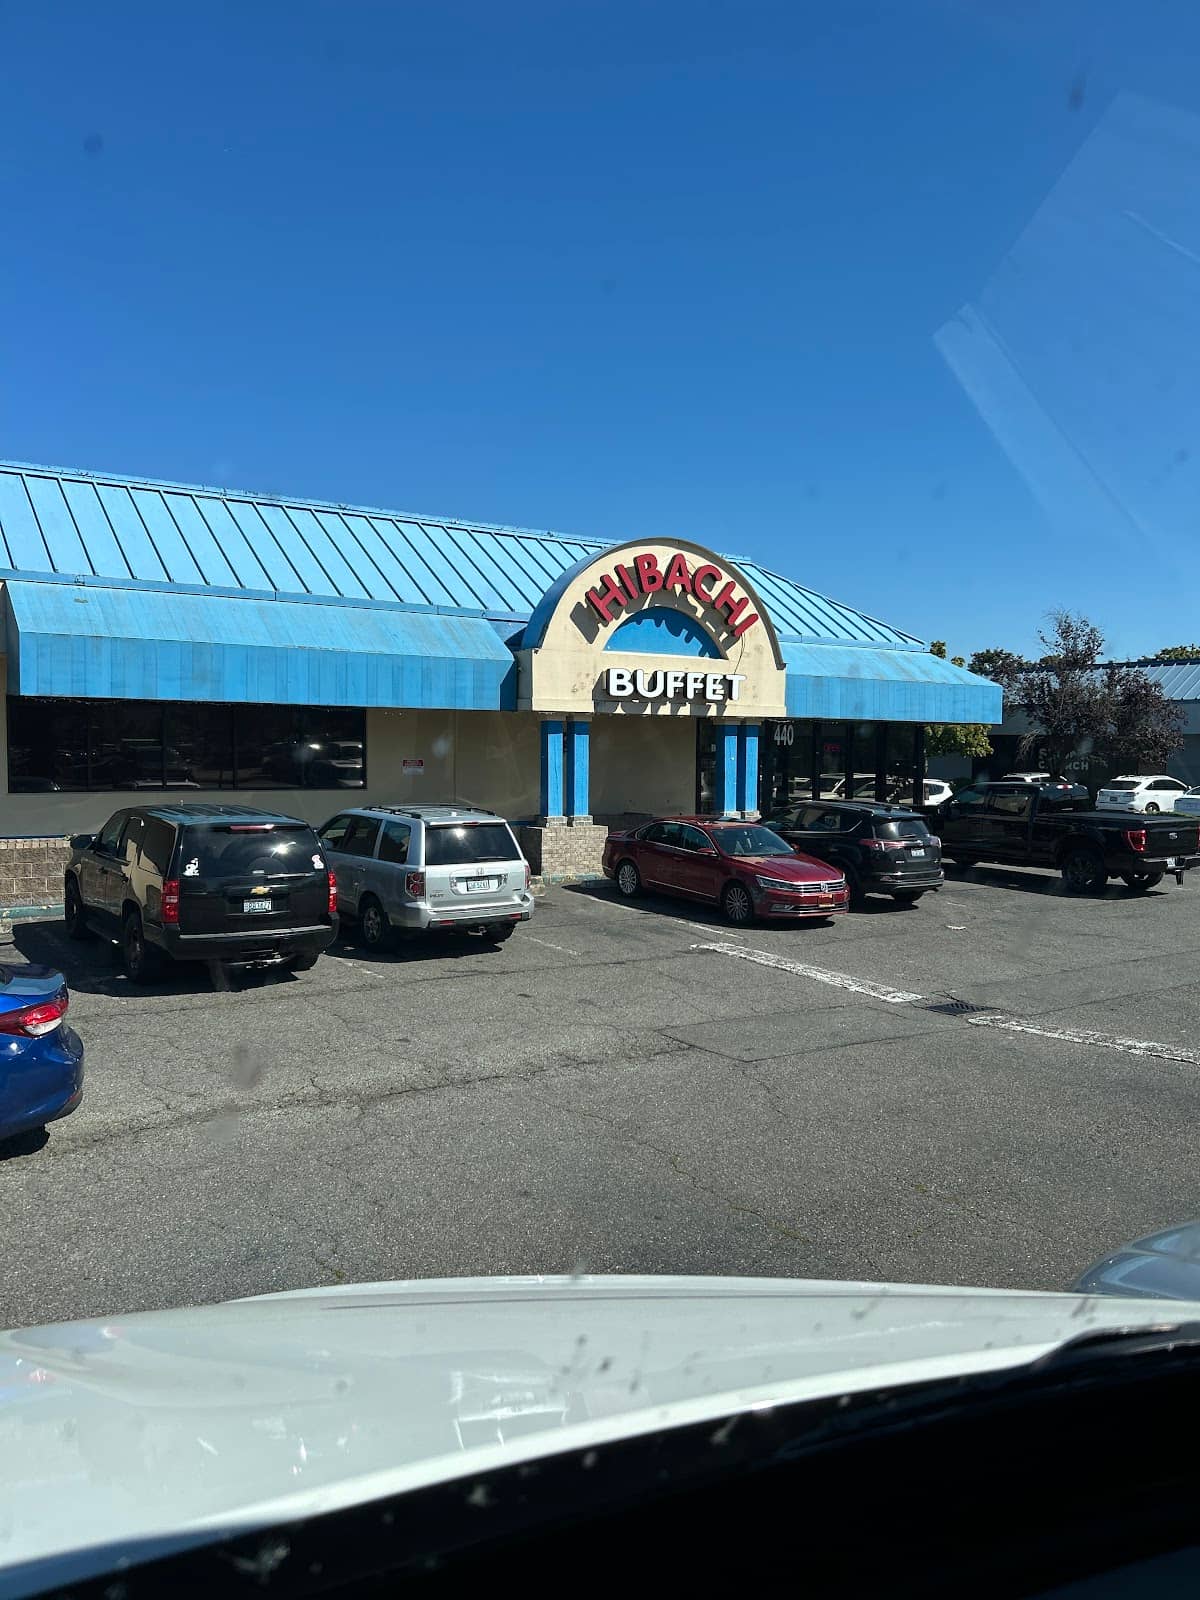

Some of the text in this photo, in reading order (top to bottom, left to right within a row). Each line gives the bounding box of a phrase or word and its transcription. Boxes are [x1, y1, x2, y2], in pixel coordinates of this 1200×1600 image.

[586, 553, 759, 637] HIBACHI
[608, 668, 747, 701] BUFFET
[773, 724, 794, 746] 440
